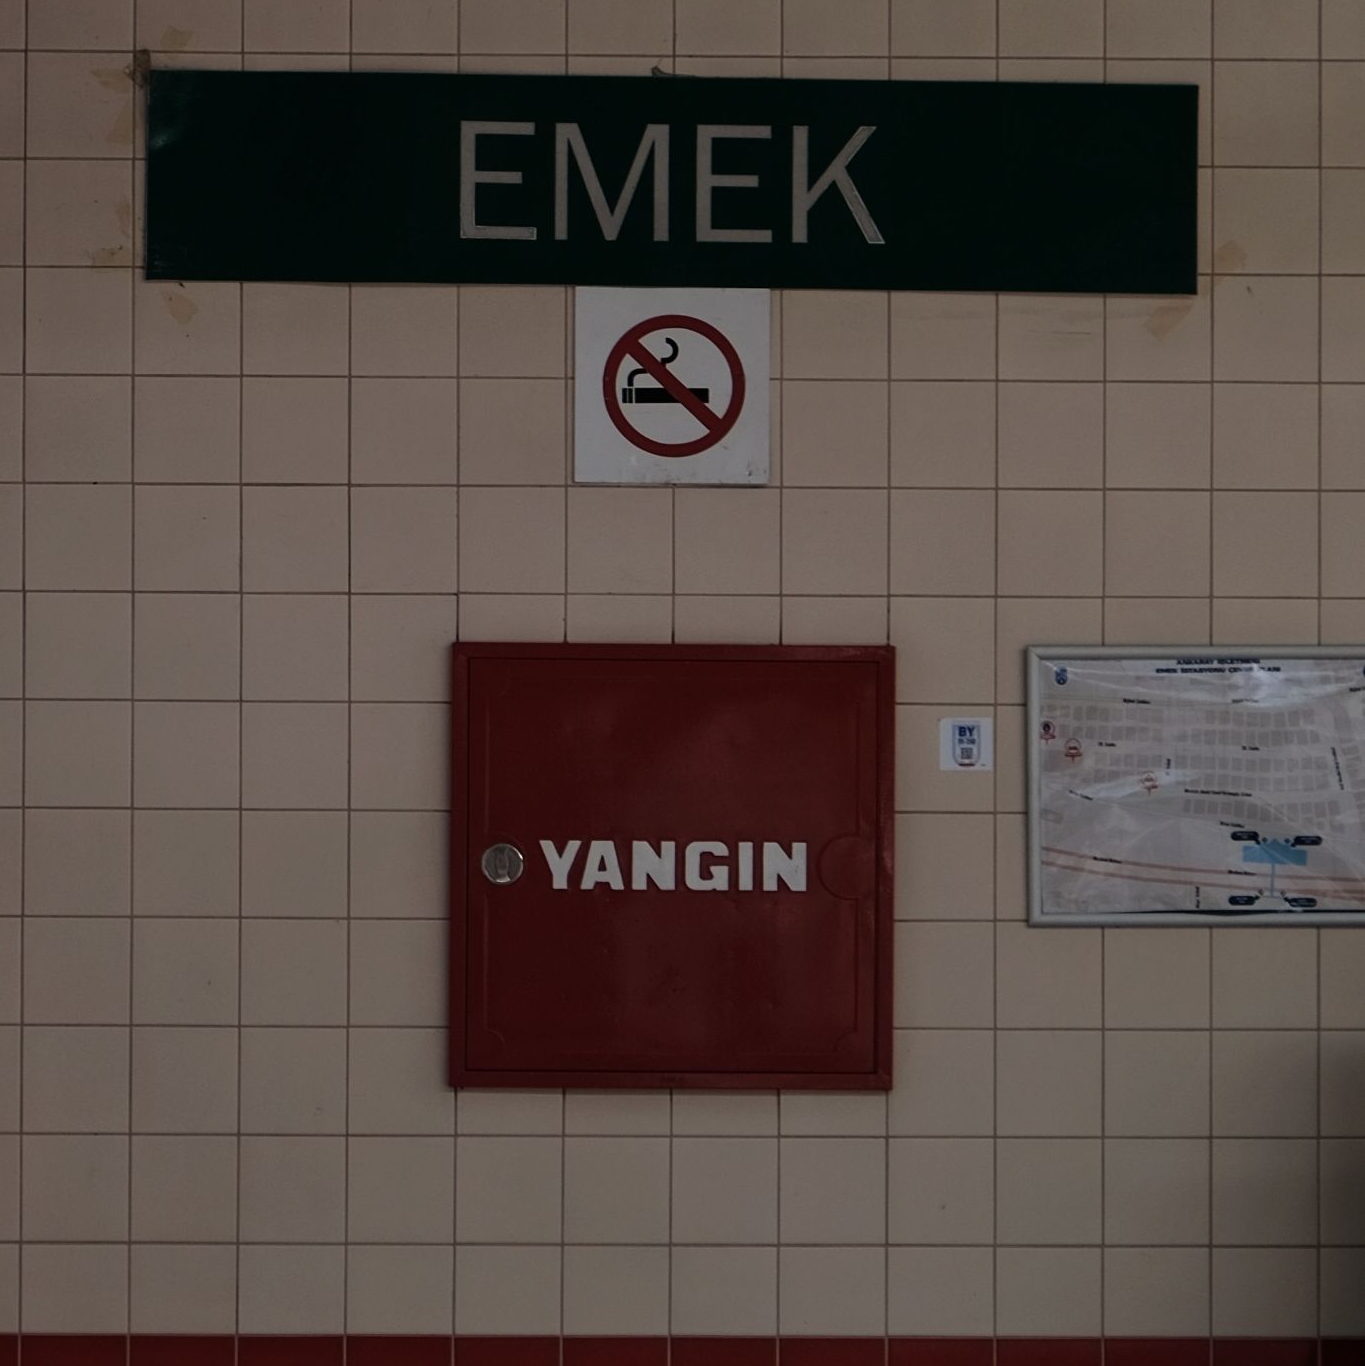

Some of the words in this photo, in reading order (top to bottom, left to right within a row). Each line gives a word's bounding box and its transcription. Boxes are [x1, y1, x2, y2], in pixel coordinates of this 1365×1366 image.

[459, 120, 886, 244] EMEK
[958, 726, 976, 737] BY
[539, 839, 807, 892] YANGIN
